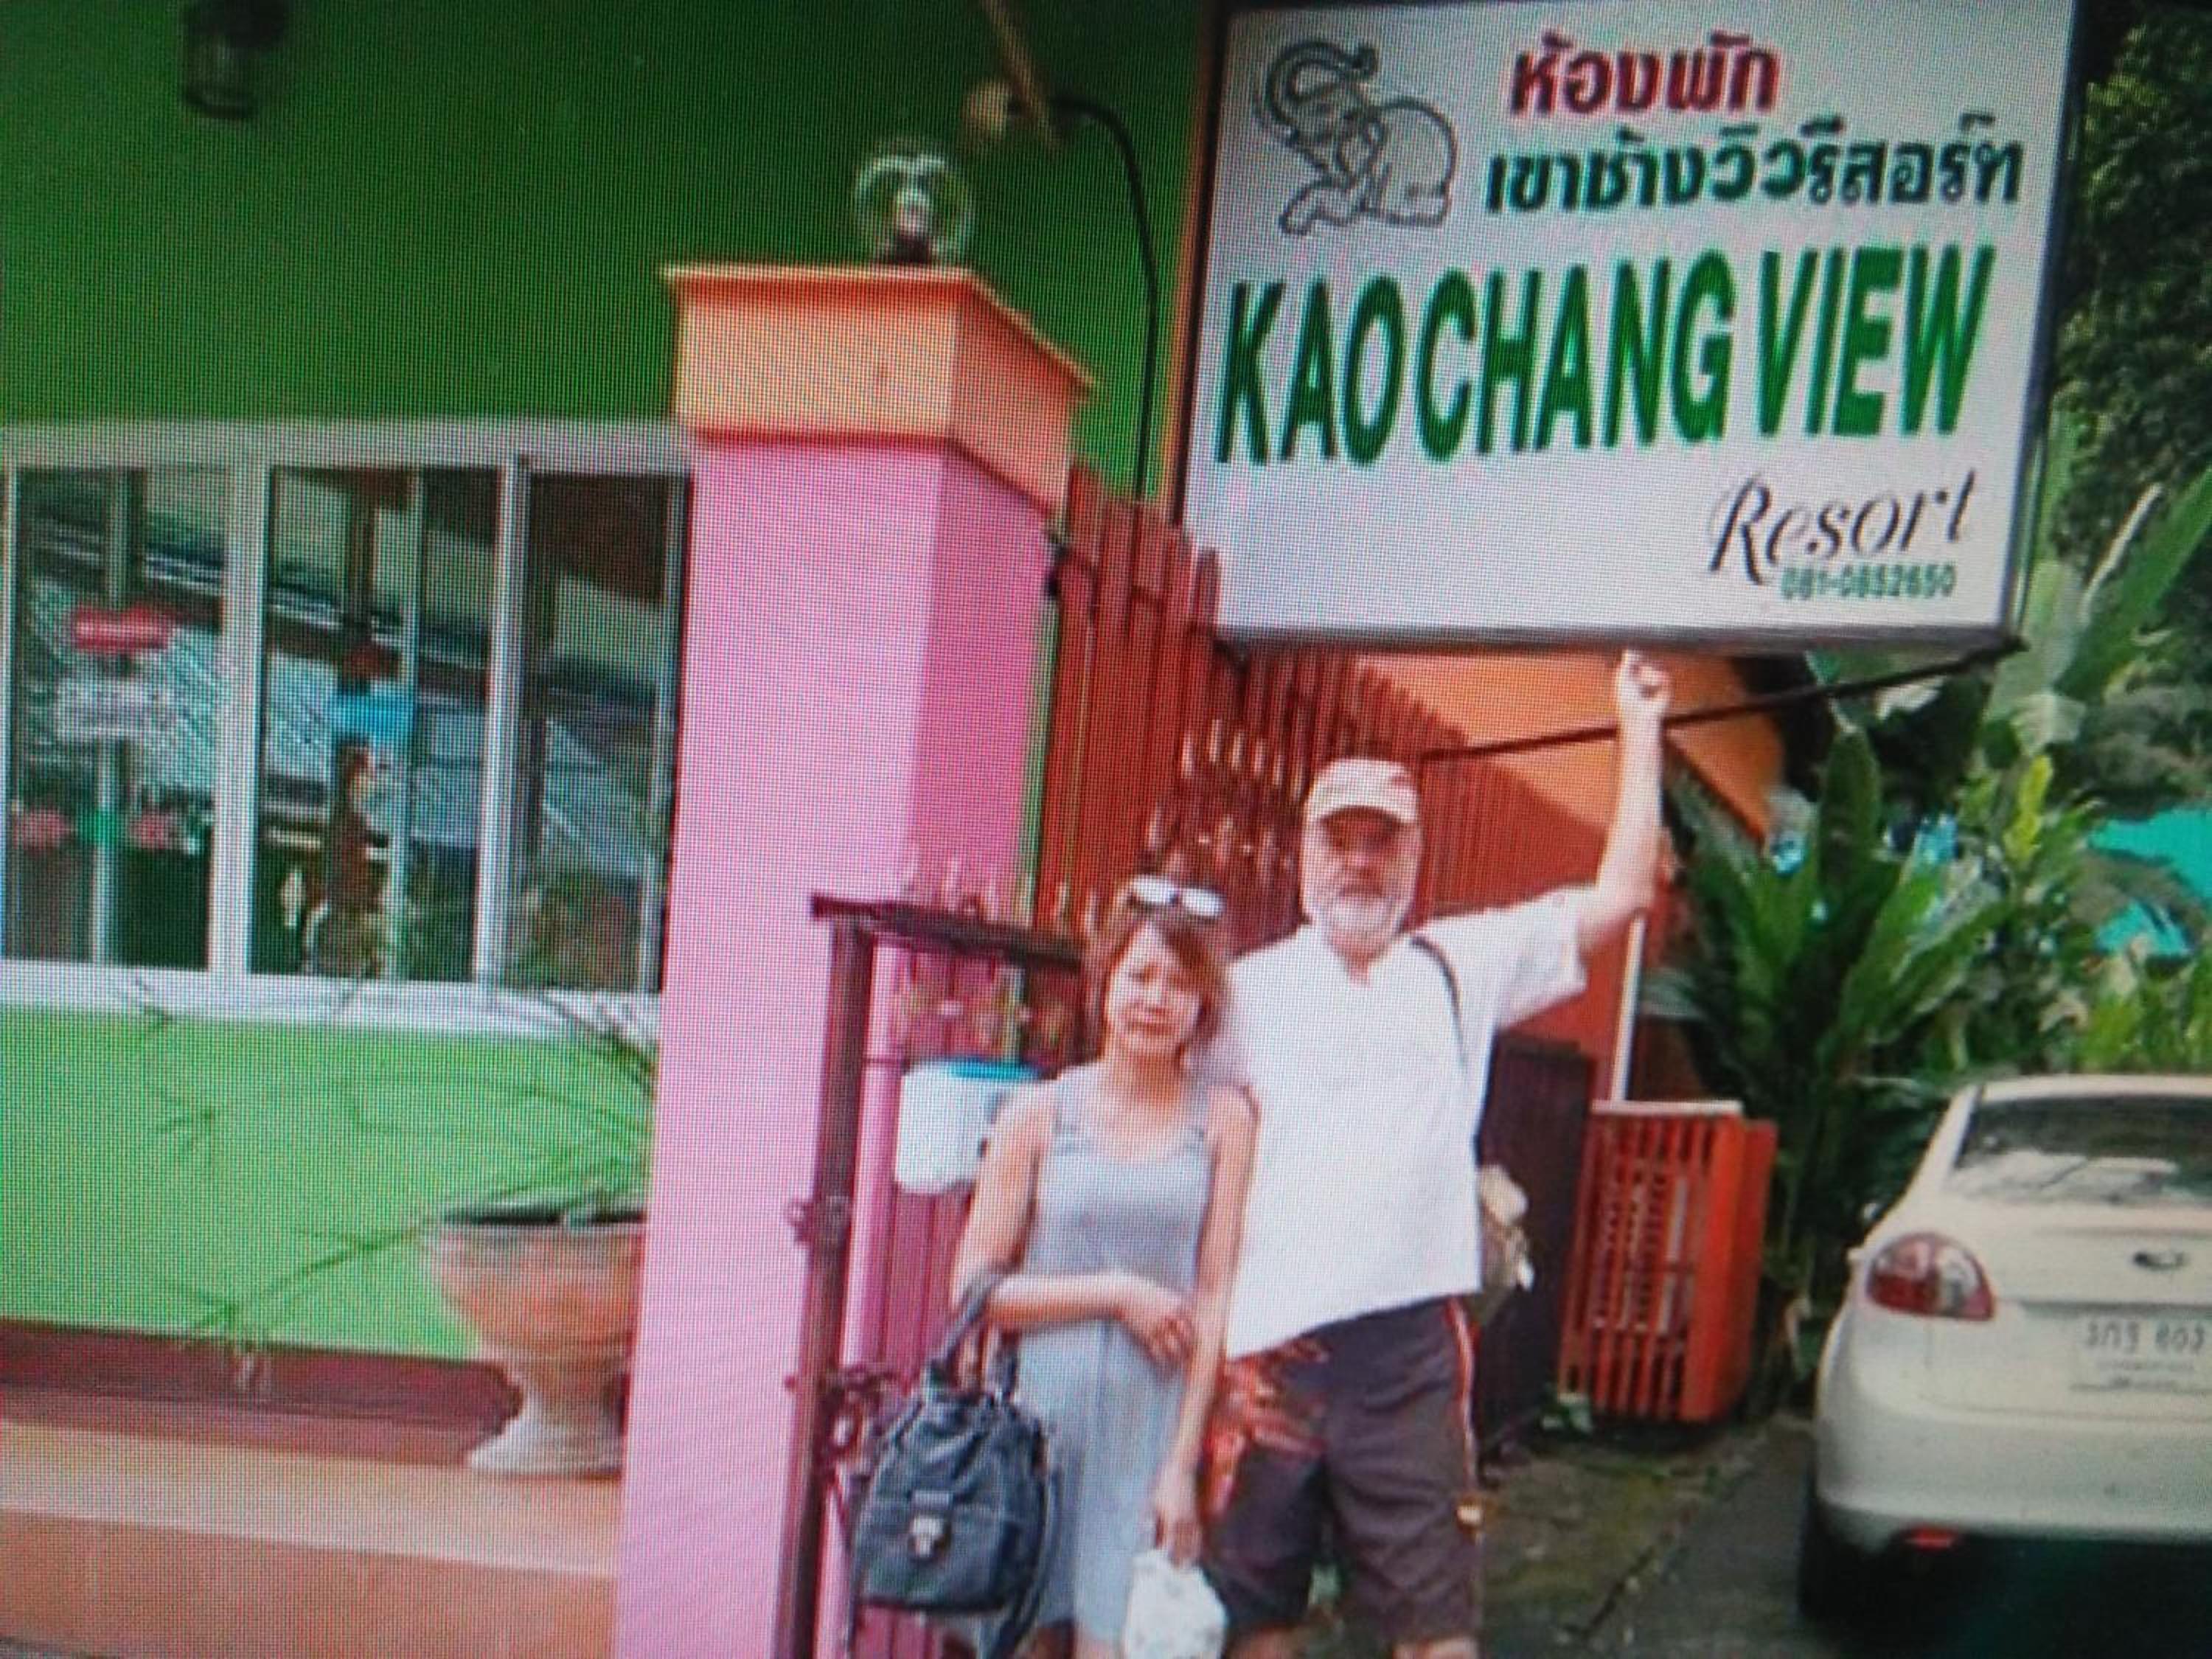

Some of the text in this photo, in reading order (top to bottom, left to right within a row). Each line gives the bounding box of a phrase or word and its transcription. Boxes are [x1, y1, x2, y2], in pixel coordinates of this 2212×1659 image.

[1509, 29, 1781, 114] ห้องพัก
[1757, 244, 1996, 438] VIEW
[1708, 467, 1976, 587] Resort
